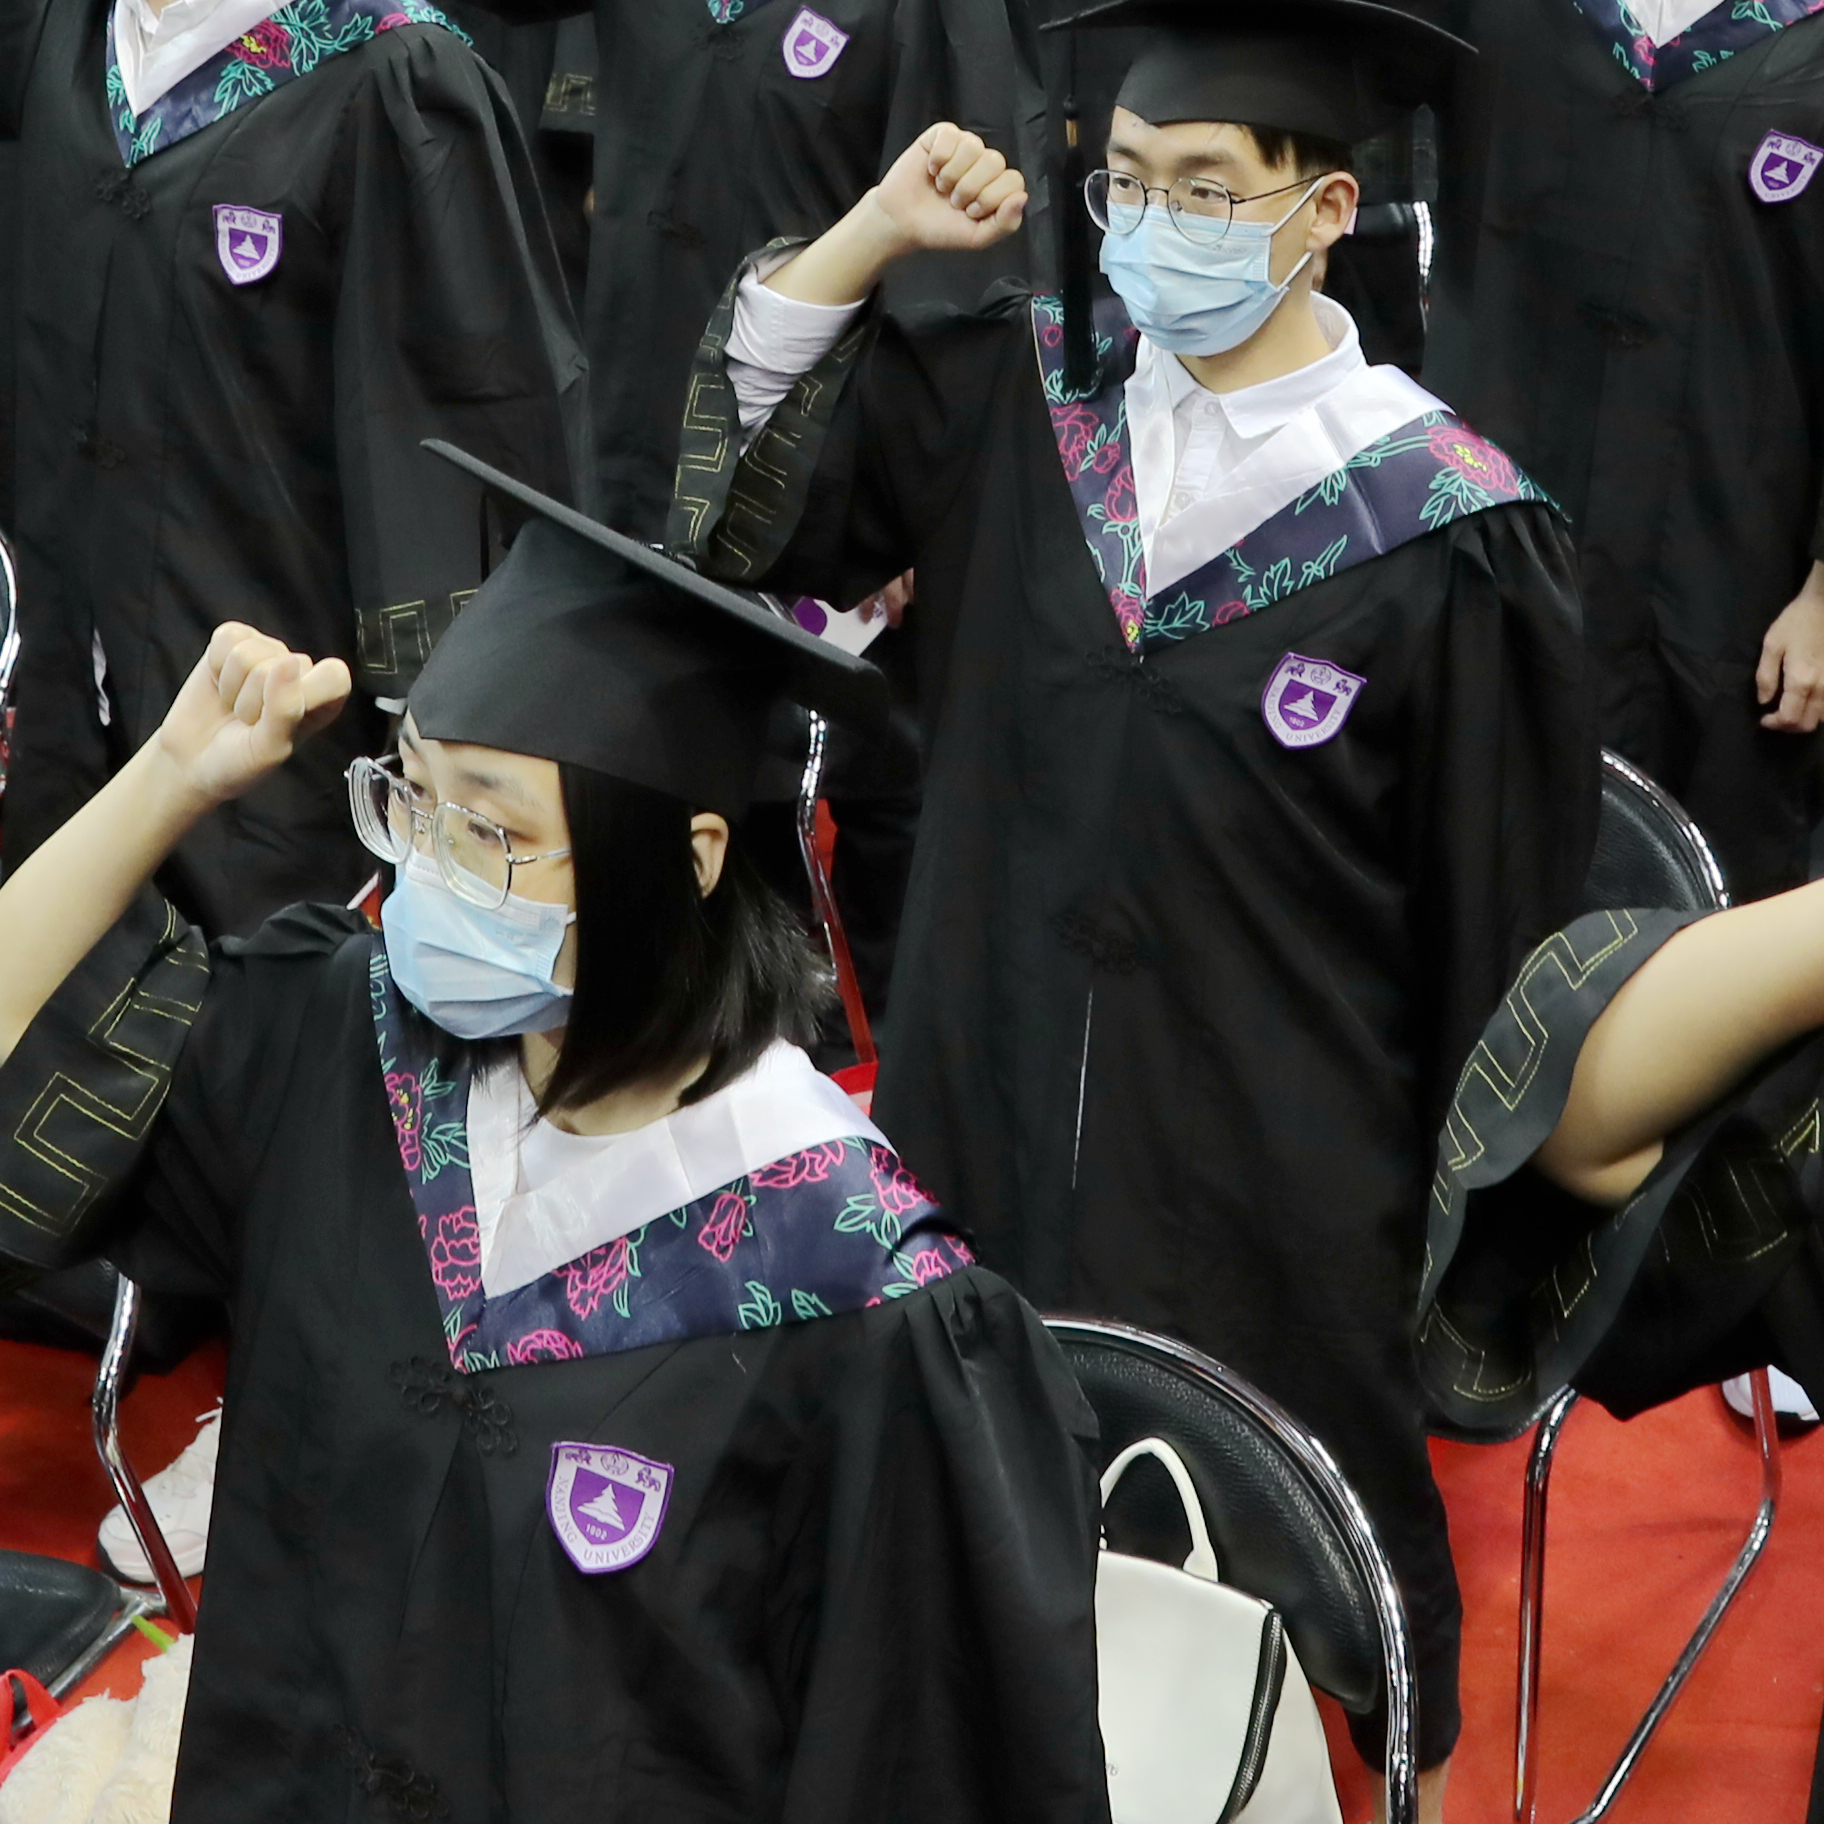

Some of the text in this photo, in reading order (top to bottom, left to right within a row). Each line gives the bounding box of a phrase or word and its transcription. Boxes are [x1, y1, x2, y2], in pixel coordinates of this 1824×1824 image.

[1286, 709, 1340, 743] UNIVERSITY
[552, 1477, 655, 1564] NANJING UNIVERSITY
